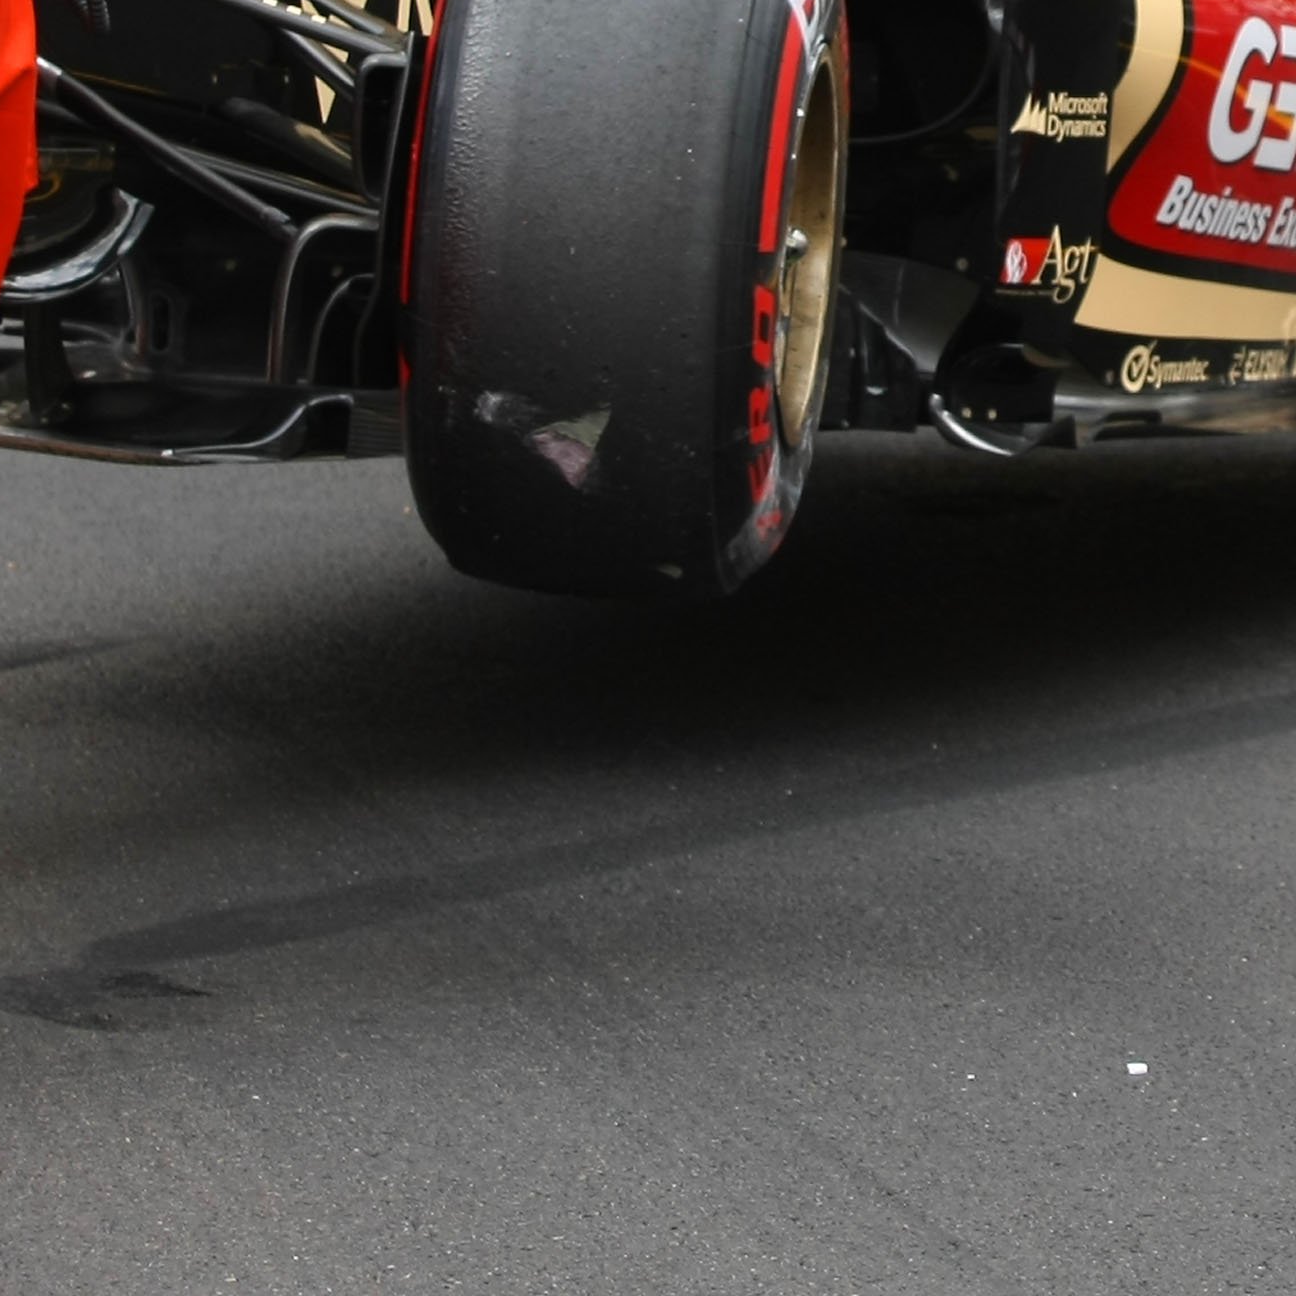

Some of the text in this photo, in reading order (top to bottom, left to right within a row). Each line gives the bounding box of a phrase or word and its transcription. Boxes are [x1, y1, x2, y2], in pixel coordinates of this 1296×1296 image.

[1048, 92, 1108, 114] Microsoft
[1047, 114, 1106, 142] Dynamics
[1156, 174, 1272, 244] Business
[1147, 355, 1211, 390] Symantec
